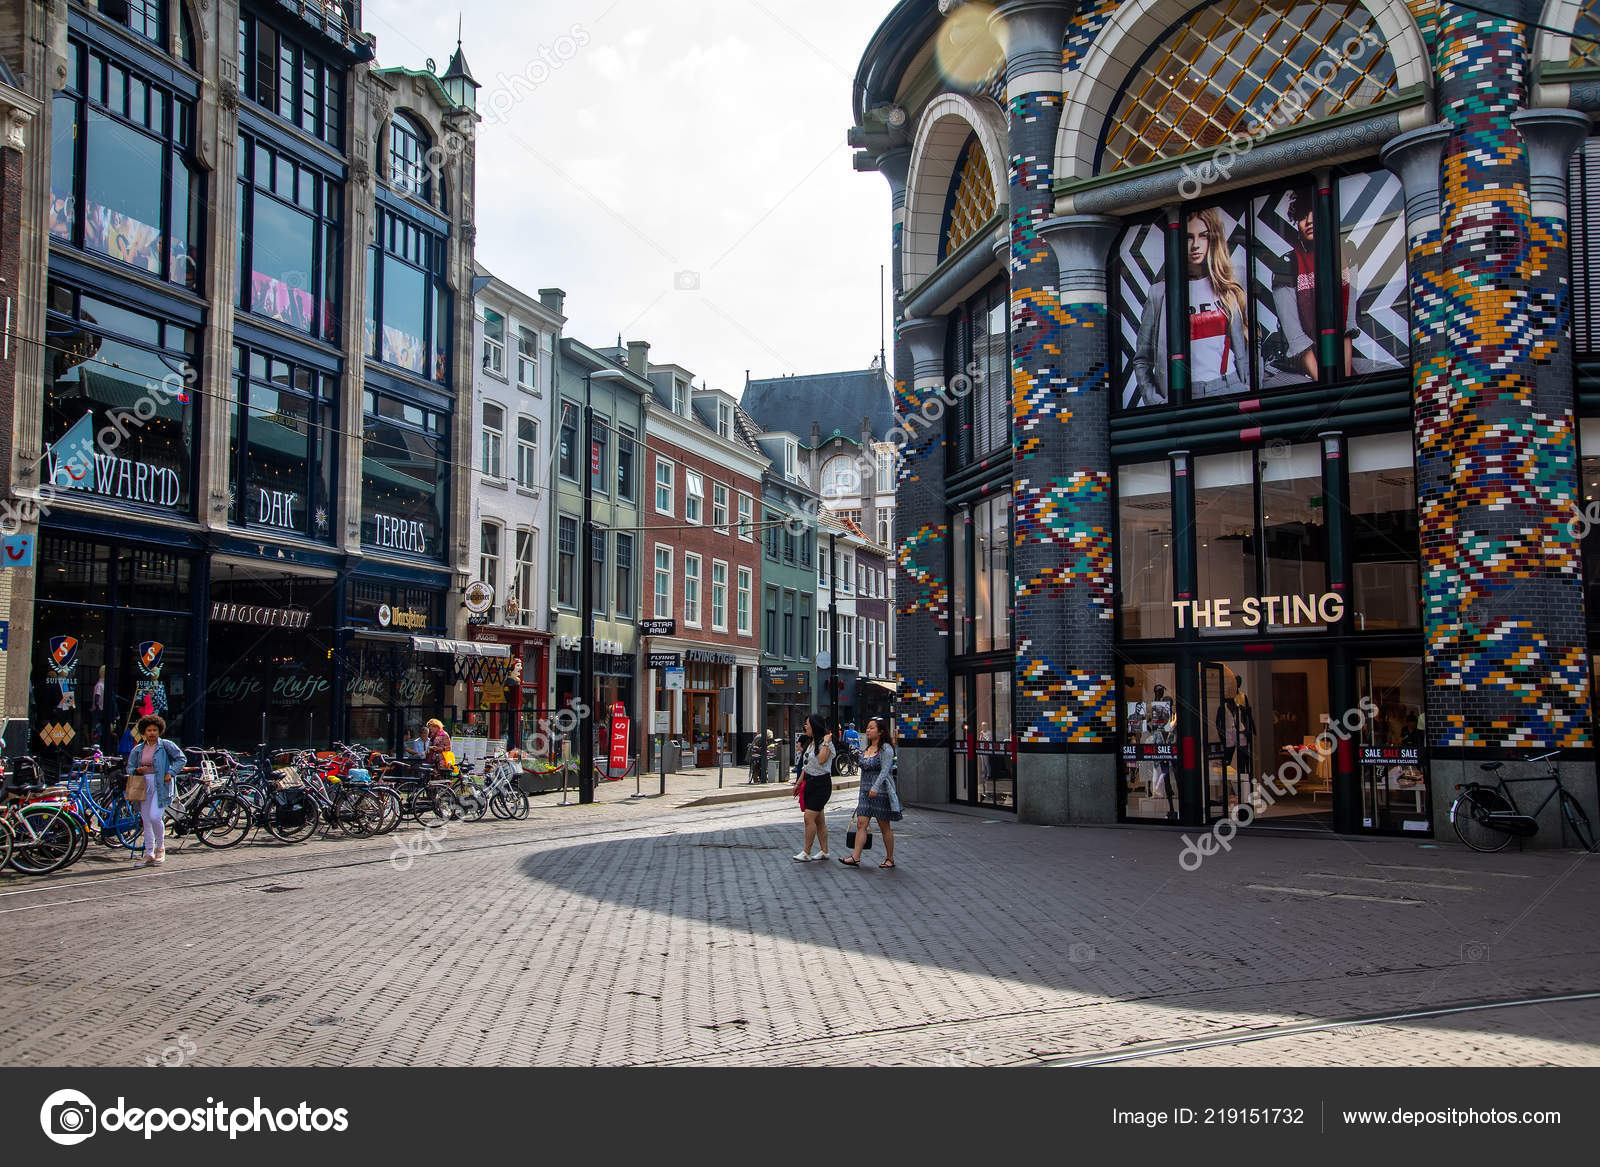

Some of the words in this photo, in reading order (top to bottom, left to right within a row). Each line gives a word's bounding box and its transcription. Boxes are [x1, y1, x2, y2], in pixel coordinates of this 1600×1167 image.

[45, 442, 180, 506] VWARMD
[258, 488, 294, 529] DAK
[375, 513, 426, 553] TERRAS
[211, 603, 277, 625] HAAGSCHE
[281, 610, 311, 628] BLUF
[392, 606, 427, 629] Warsteiner
[1172, 598, 1232, 629] THE
[1242, 592, 1345, 627] STING
[58, 641, 69, 657] S
[147, 646, 156, 661] S
[690, 649, 715, 663] FLYING
[717, 652, 737, 665] TIGER
[613, 722, 626, 762] SALE
[1123, 746, 1136, 754] SALE
[1143, 746, 1156, 754] SALE
[1157, 746, 1171, 754] SALE
[1365, 749, 1381, 757] SALE
[1384, 749, 1399, 757] SALE
[1401, 749, 1418, 757] SALE
